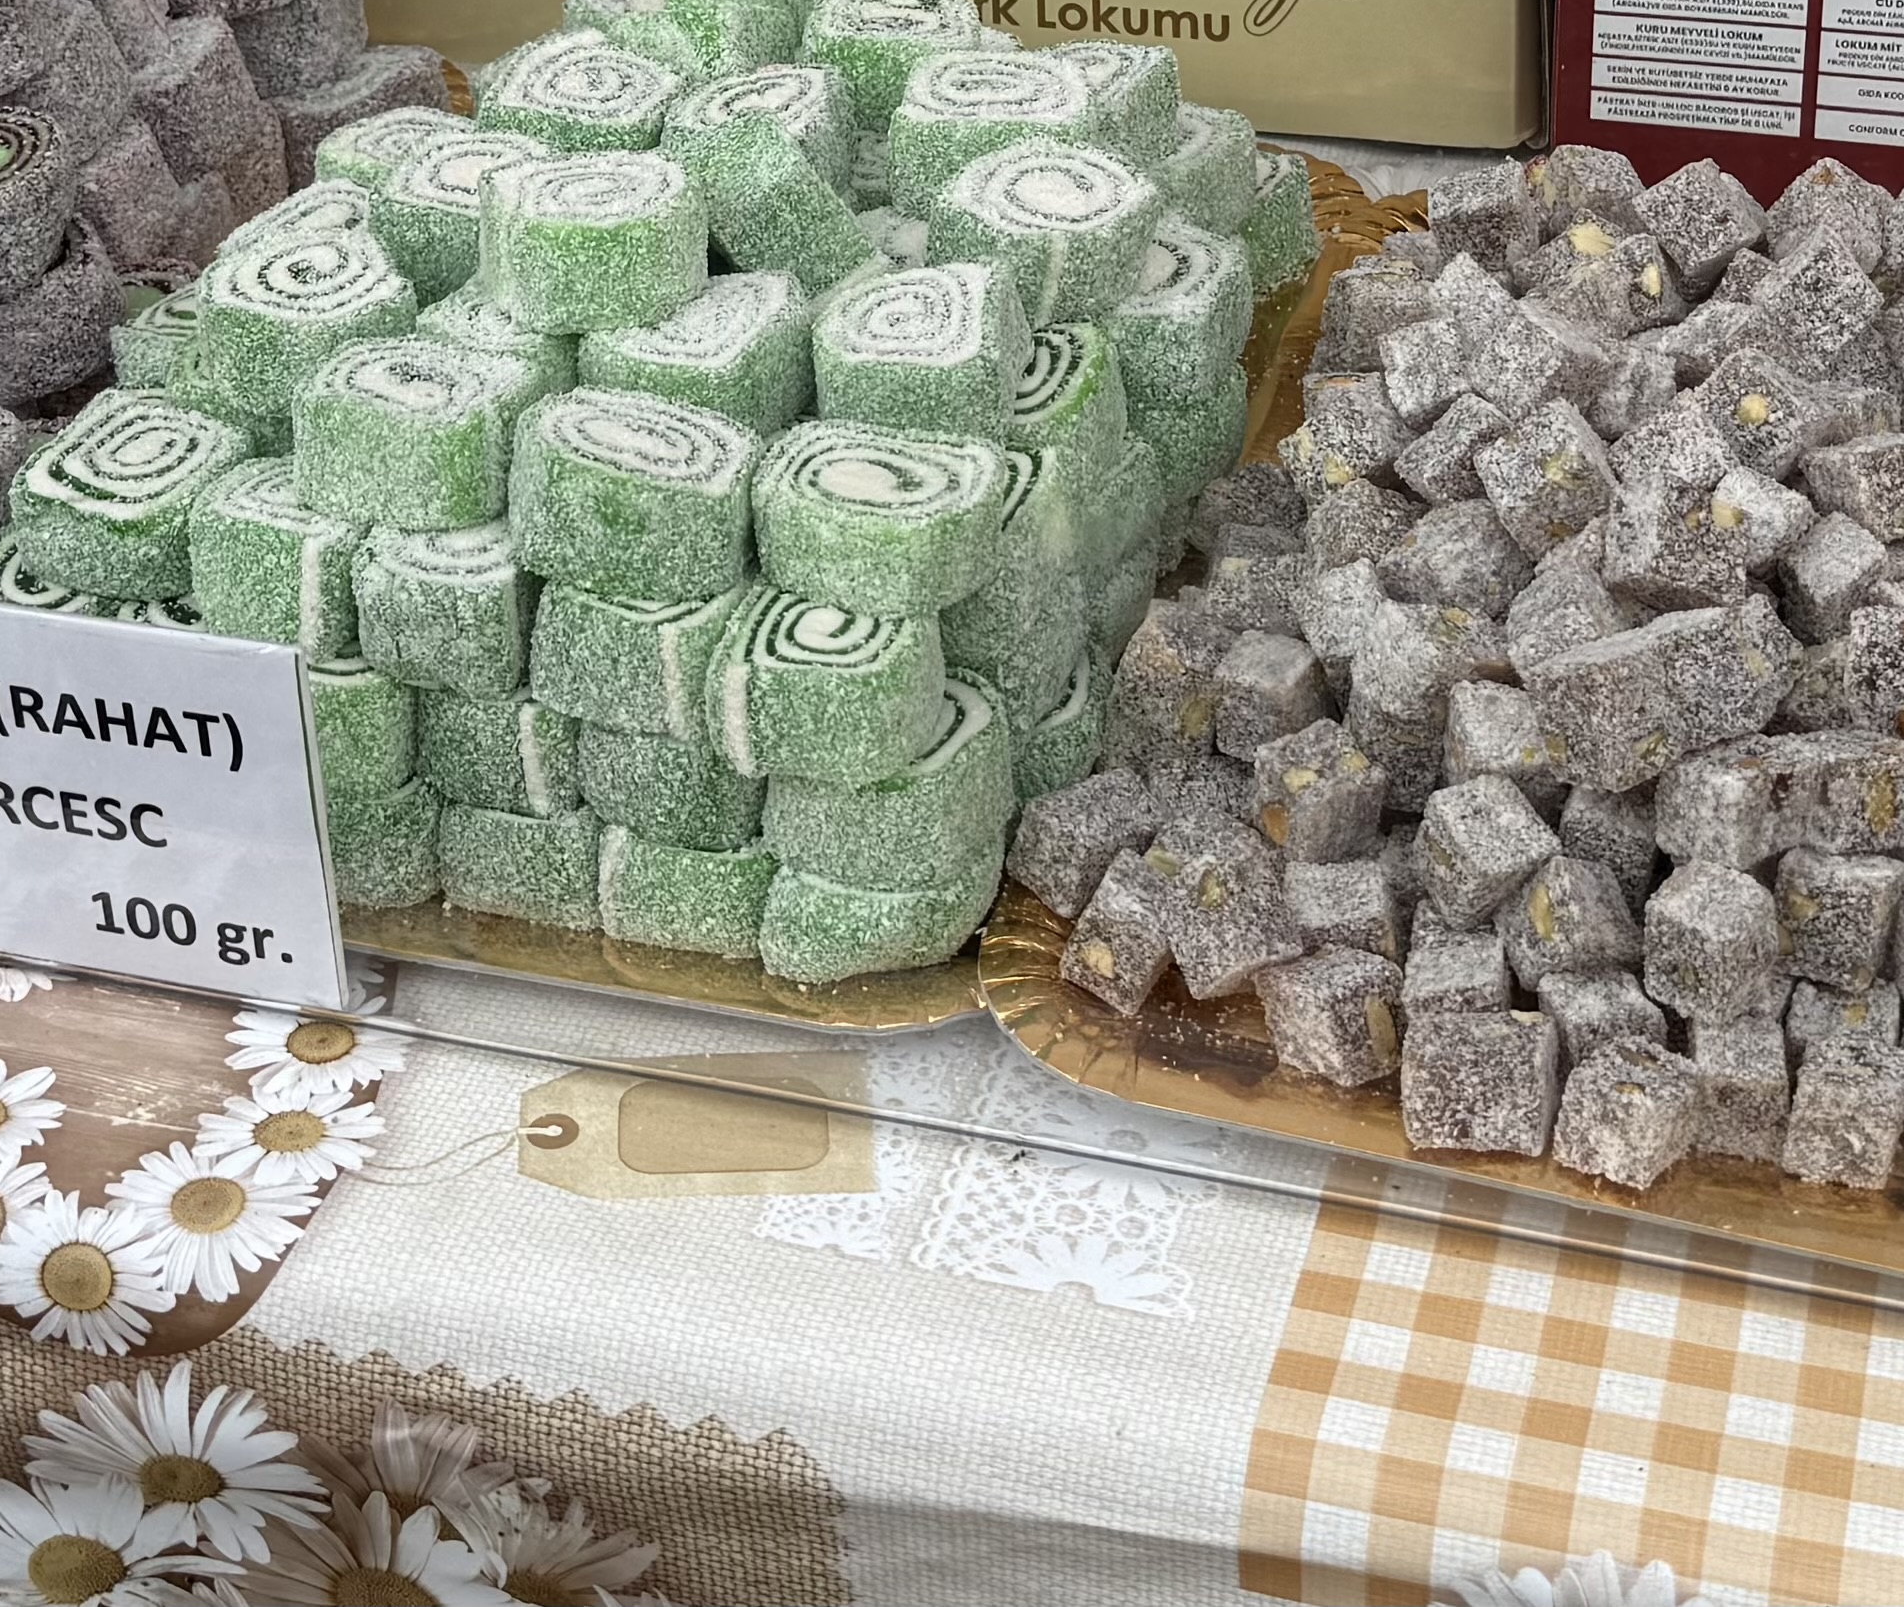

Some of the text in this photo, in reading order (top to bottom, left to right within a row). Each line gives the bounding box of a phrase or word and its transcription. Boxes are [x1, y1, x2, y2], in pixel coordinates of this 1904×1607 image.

[1669, 24, 1719, 39] MEYVELİ
[1720, 29, 1763, 42] LOKUM
[1834, 38, 1878, 52] LOKUM
[92, 892, 196, 945] 100
[217, 923, 292, 965] gr.
